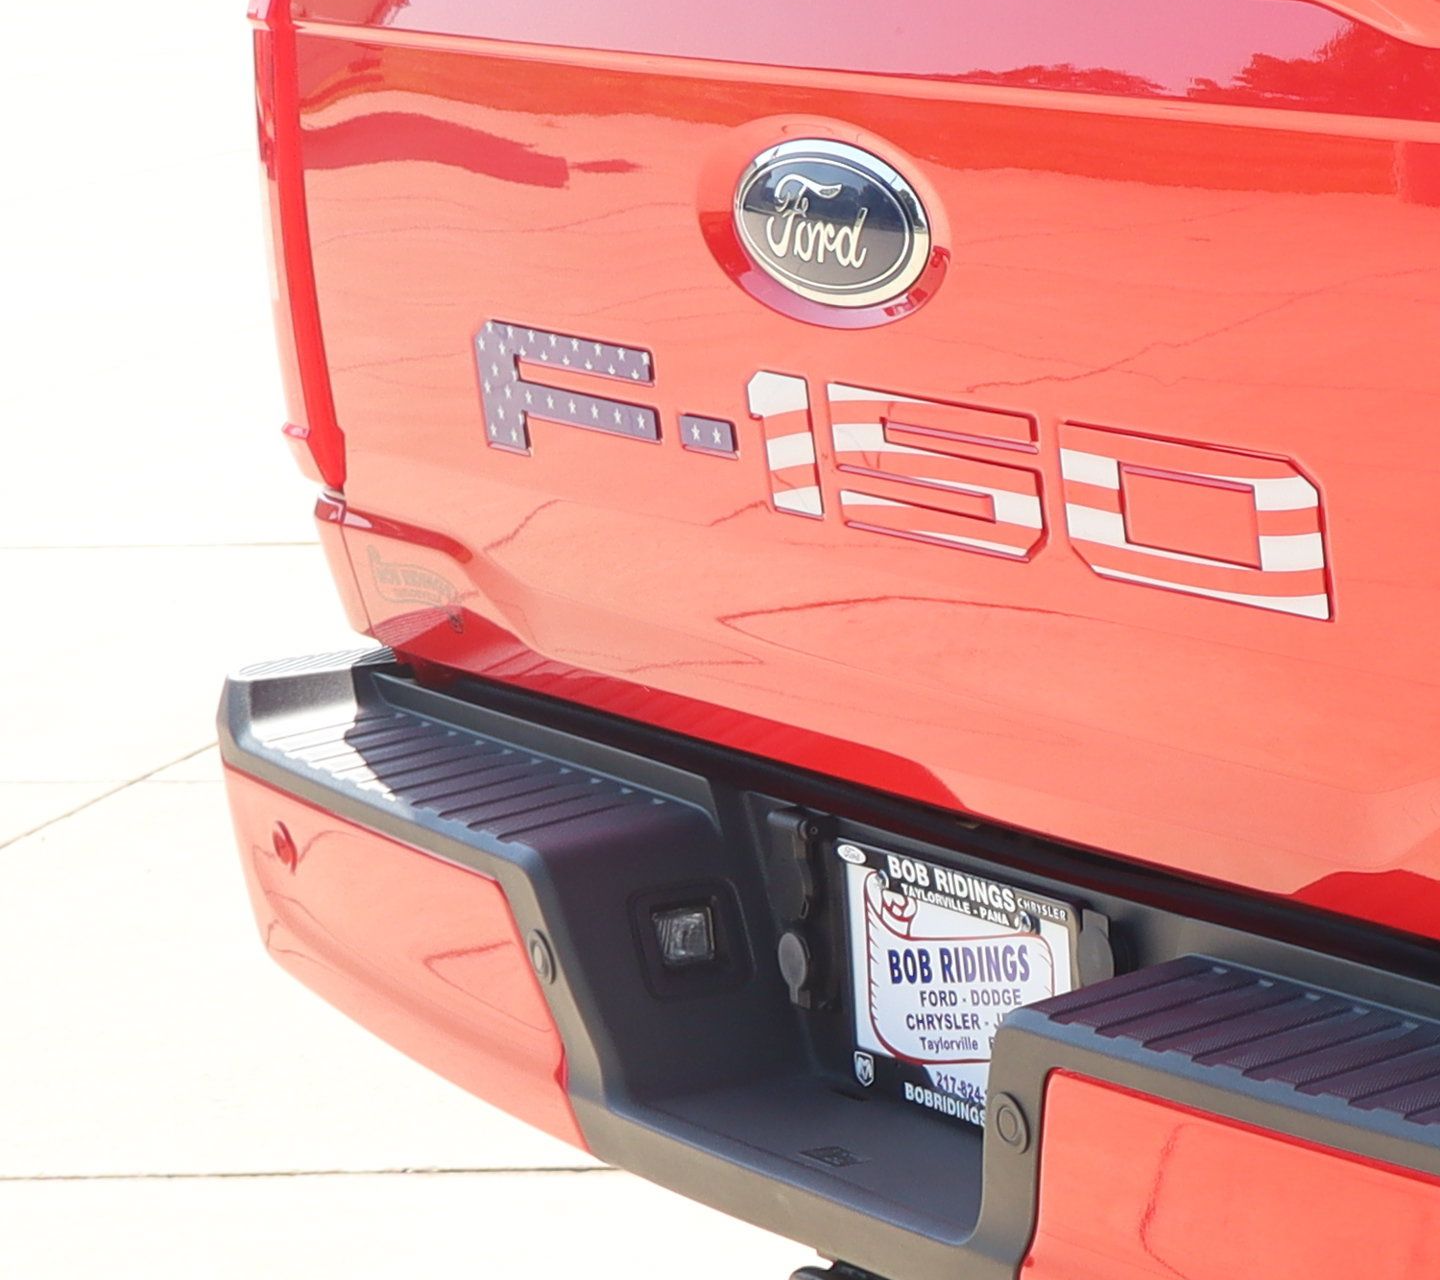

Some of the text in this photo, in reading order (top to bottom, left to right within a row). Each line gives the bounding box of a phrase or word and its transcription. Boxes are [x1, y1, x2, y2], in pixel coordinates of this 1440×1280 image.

[766, 173, 869, 269] Ford
[471, 319, 1336, 622] F-150
[887, 855, 1016, 913] BOB RIDINGS
[901, 883, 971, 915] TAYLORVILLE
[979, 906, 1010, 926] PANA
[1017, 898, 1067, 921] CHRYSLER
[887, 944, 1031, 985] BOB RIDINGS
[920, 990, 958, 1007] FORD
[971, 988, 1022, 1007] DODGE
[906, 1013, 981, 1030] CHRYSLER
[919, 1036, 978, 1054] Taylorville
